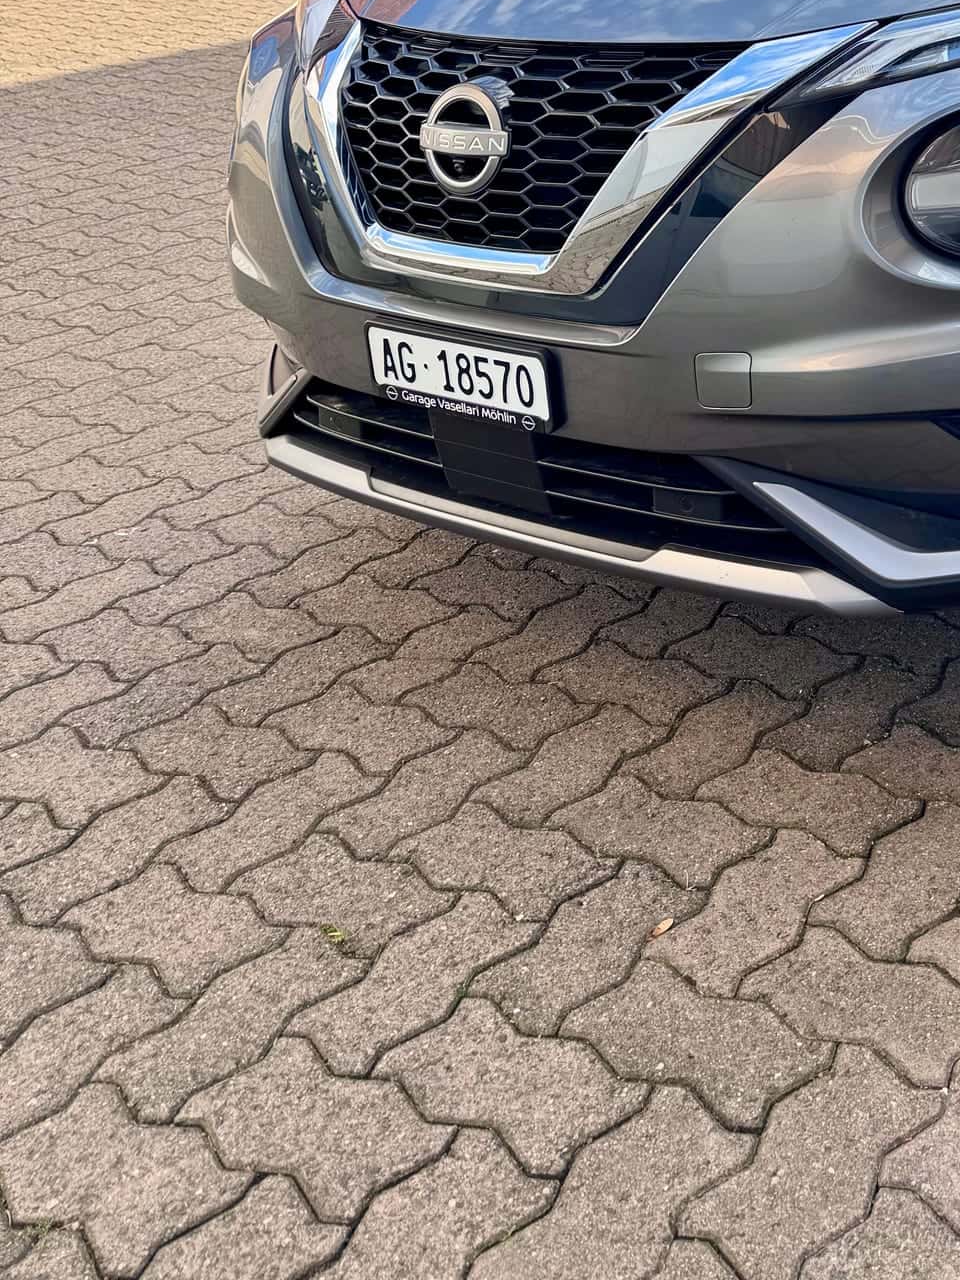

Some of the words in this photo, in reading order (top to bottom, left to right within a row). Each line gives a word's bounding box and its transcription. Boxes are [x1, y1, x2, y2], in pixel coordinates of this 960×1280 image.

[422, 129, 504, 152] NISSAN
[401, 390, 437, 409] Garage
[438, 398, 480, 417] Vasellari
[481, 408, 517, 426] Möhlin
